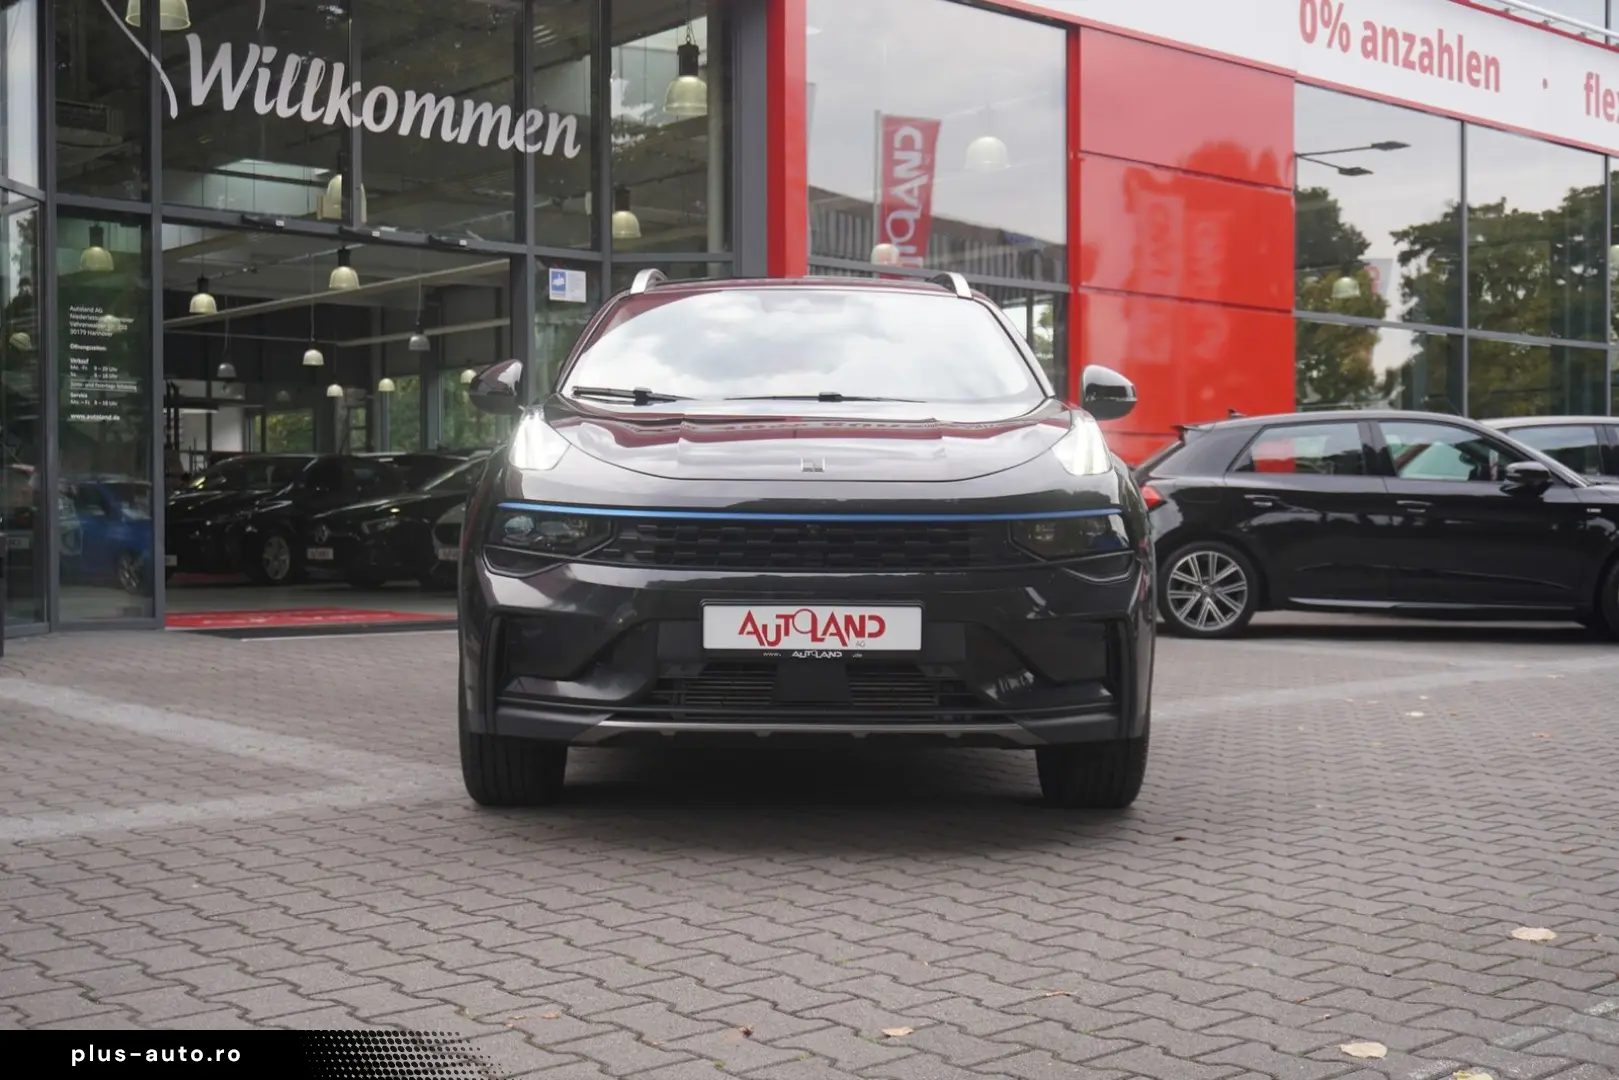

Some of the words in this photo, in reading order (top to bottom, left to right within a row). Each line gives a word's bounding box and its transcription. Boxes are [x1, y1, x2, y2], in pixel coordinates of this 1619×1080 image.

[1299, 0, 1351, 53] 0%
[1360, 20, 1501, 93] anzahlen
[185, 33, 581, 158] Willkommen
[1583, 71, 1619, 124] fle
[70, 305, 94, 313] Autoland
[87, 330, 113, 338] Hannover
[70, 413, 120, 421] www.autoland.de
[738, 608, 886, 647] AUTOLAND
[856, 640, 866, 649] AG
[791, 649, 843, 659] AUTOLAND
